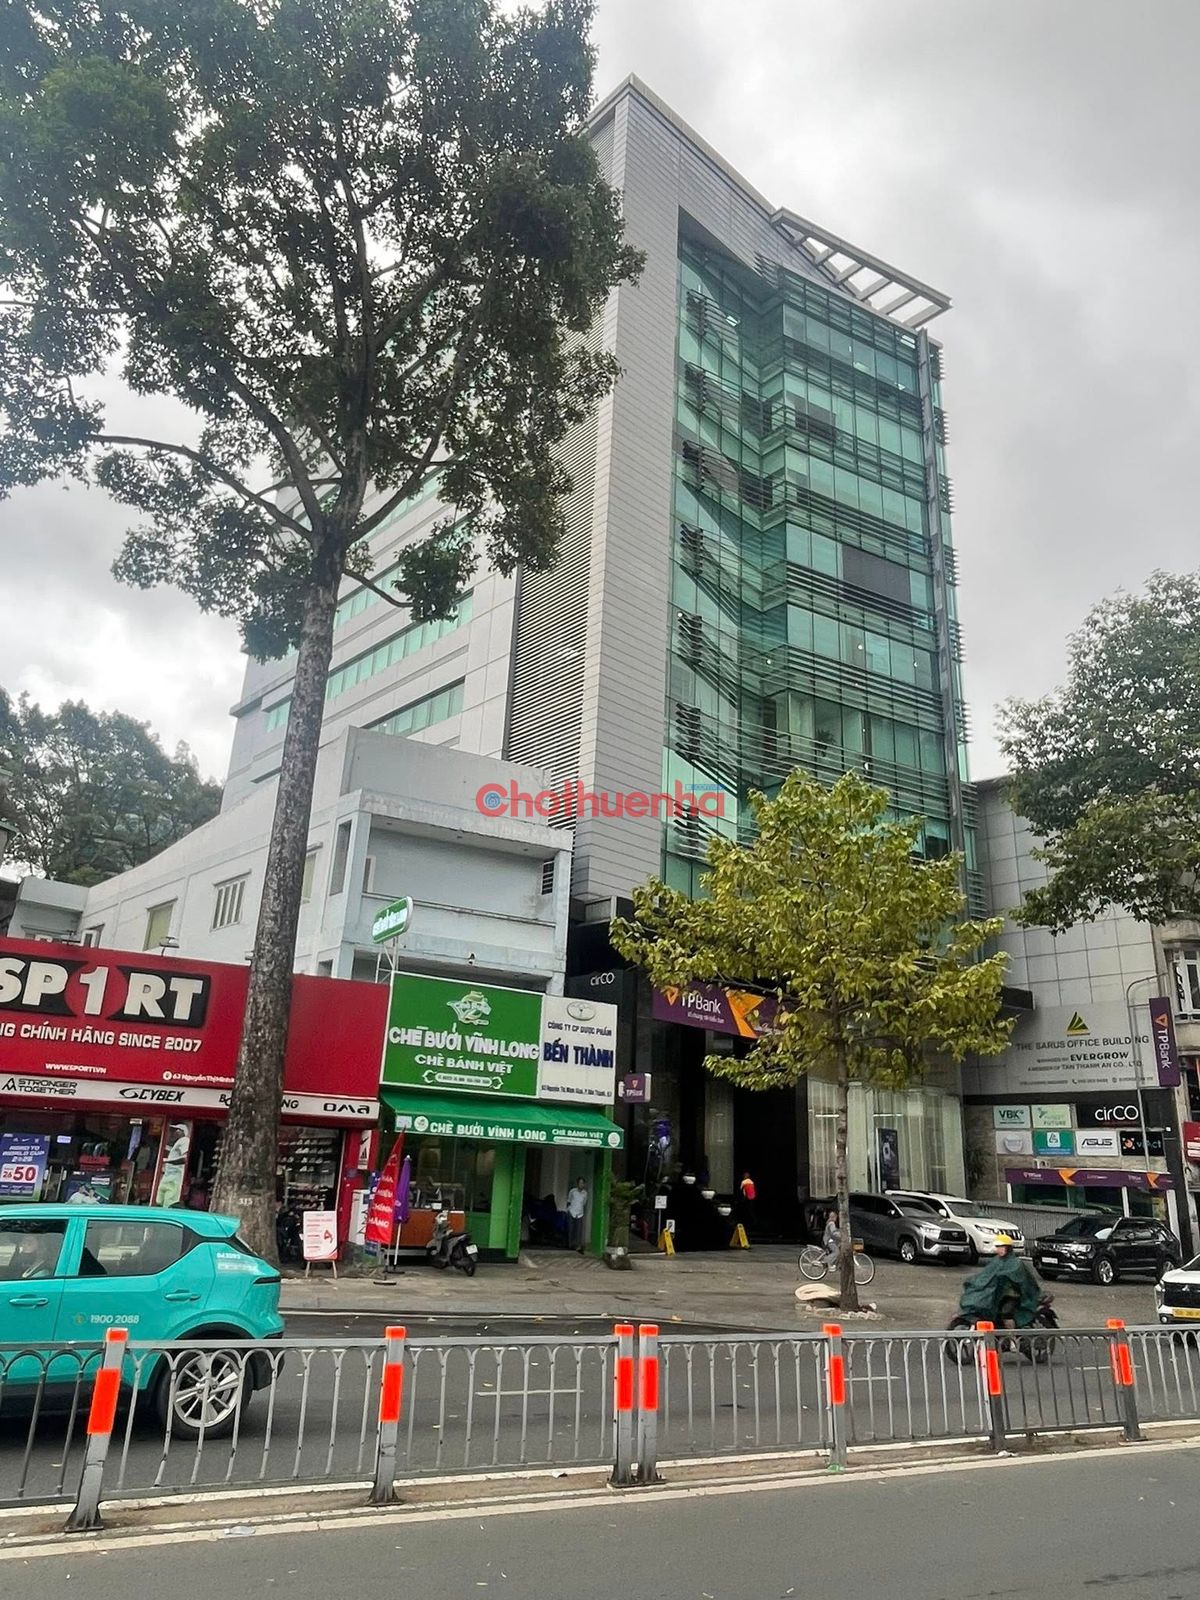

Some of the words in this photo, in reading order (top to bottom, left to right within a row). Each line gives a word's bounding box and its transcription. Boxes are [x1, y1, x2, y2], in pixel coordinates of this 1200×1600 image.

[20, 1021, 67, 1041] CHÍNH
[71, 1026, 115, 1045] HÃNG
[118, 1034, 161, 1049] SINCE
[164, 1036, 202, 1052] 2007
[424, 1023, 462, 1051] BƯỞI
[464, 1032, 499, 1055] VĨNH
[500, 1040, 540, 1060] LONG
[1016, 1043, 1032, 1051] THE
[1036, 1041, 1066, 1050] SARUS
[1067, 1038, 1100, 1048] OFFICE
[1103, 1035, 1150, 1046] BUILDNG
[543, 1038, 569, 1063] BẾN
[573, 1044, 614, 1068] THÀNH
[1070, 1051, 1129, 1062] EVERGROW
[1157, 1029, 1173, 1069] TPBank
[414, 1053, 444, 1067] CHÈ
[446, 1056, 484, 1071] BÁNH
[487, 1061, 513, 1076] VIỆT
[18, 1079, 77, 1089] STRONGER
[18, 1086, 76, 1096] TOGETHER
[1094, 1105, 1139, 1121] cirCO
[430, 1120, 453, 1133] CHÈ
[457, 1121, 484, 1136] BƯỞI
[518, 1130, 547, 1141] LONG
[1081, 1138, 1113, 1146] ASUS
[90, 1315, 113, 1324] 1900
[114, 1315, 139, 1323] 2088
